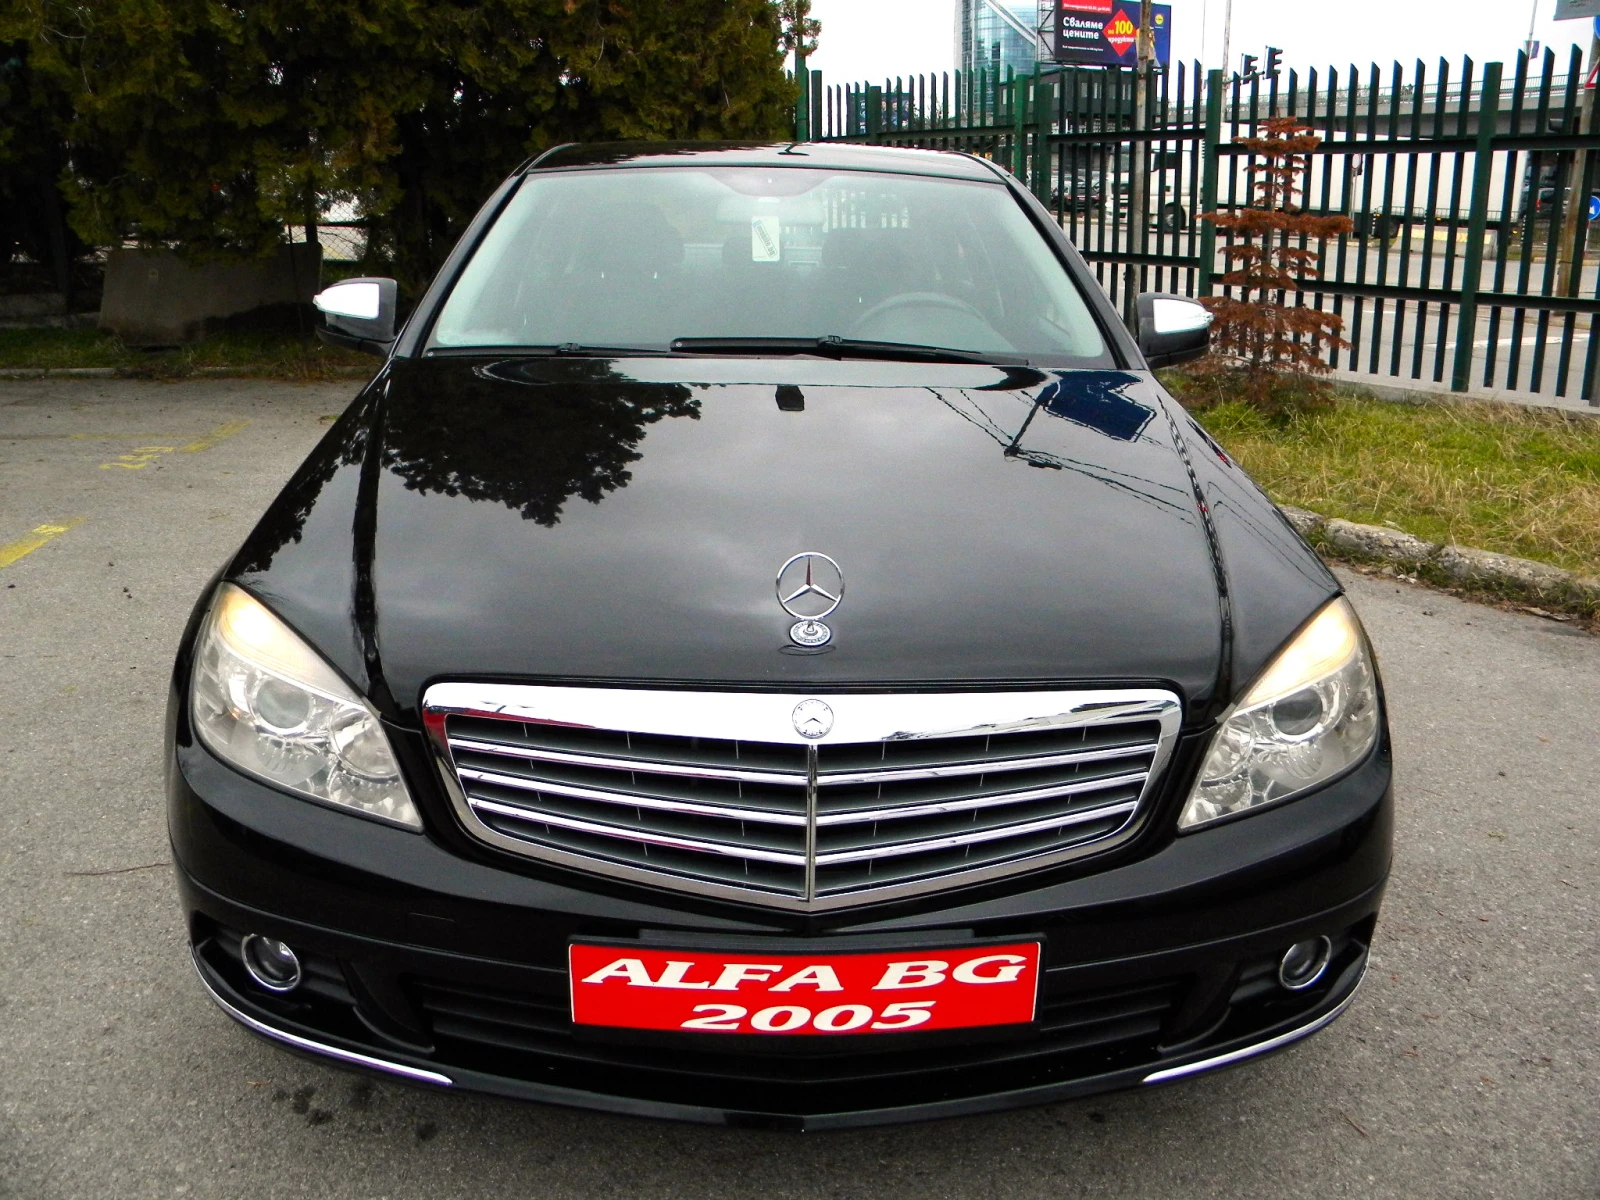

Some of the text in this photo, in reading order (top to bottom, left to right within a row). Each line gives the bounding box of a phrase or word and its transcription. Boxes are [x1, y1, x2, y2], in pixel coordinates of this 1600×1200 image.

[1063, 17, 1103, 30] Сваляме
[1114, 20, 1134, 35] 100
[1062, 29, 1099, 39] цените
[581, 954, 1026, 992] ALFA BG
[681, 1000, 936, 1032] 2005
